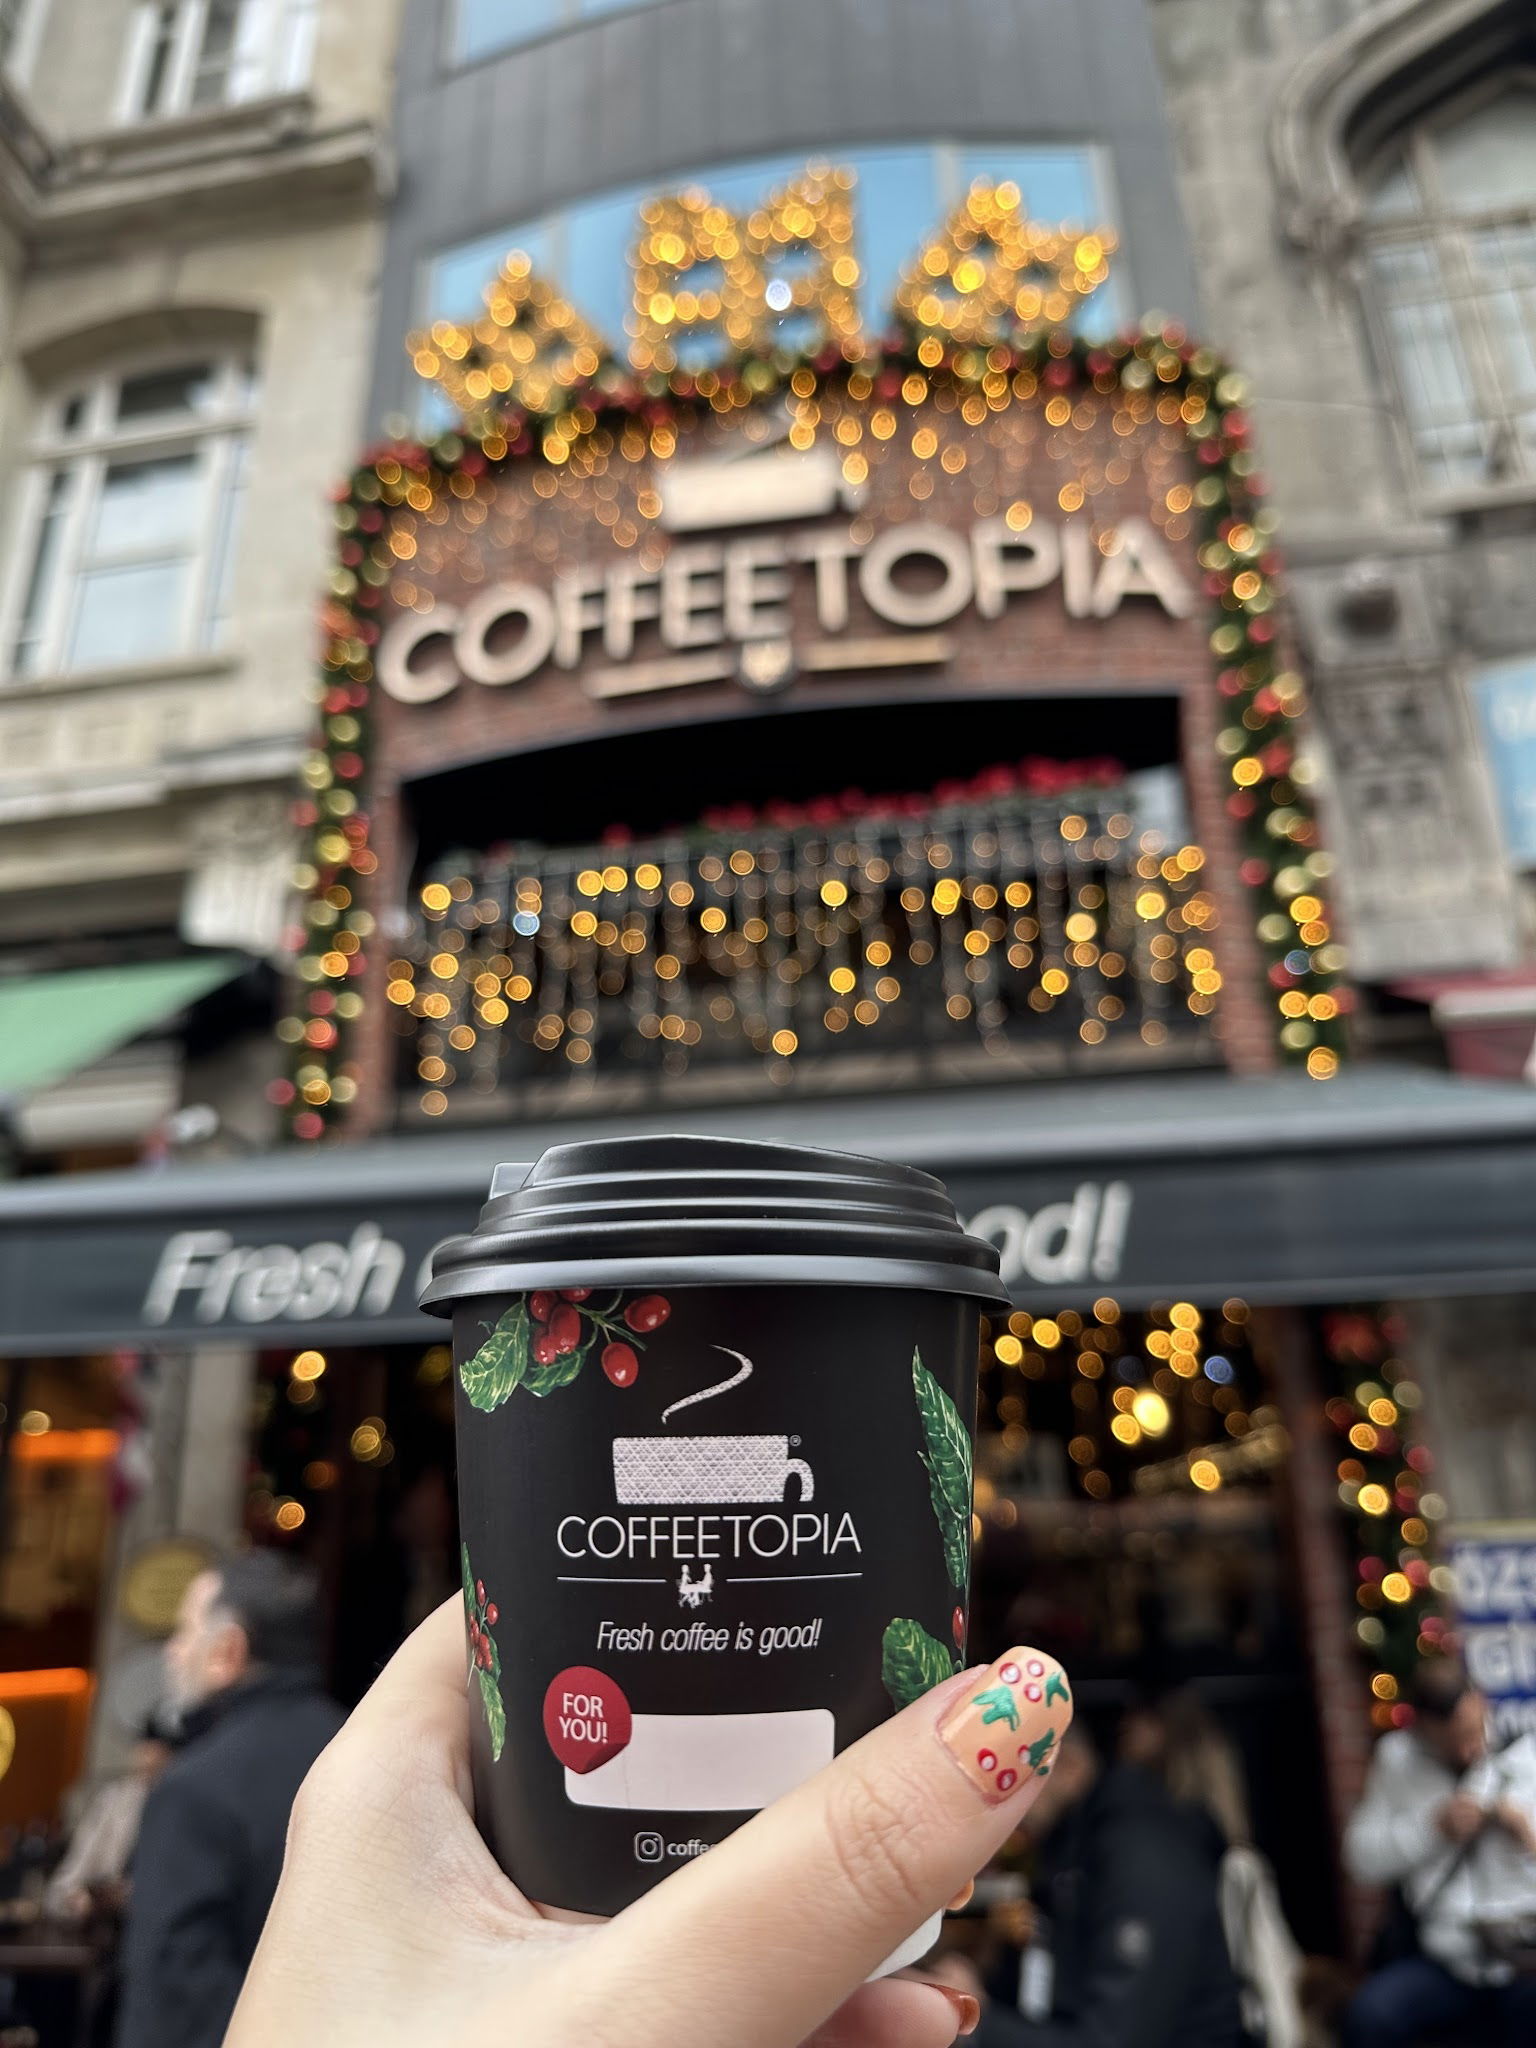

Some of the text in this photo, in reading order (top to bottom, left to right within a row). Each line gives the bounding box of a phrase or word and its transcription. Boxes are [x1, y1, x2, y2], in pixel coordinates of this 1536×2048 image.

[377, 517, 1197, 704] COFFEETOPIA
[142, 1221, 406, 1326] Fresh
[556, 1512, 863, 1559] COFFEETOPIA
[597, 1617, 823, 1656] Fresh coffee is good!
[562, 1692, 604, 1718] FOR
[558, 1715, 608, 1744] YOU!
[666, 1838, 716, 1856] coffe
